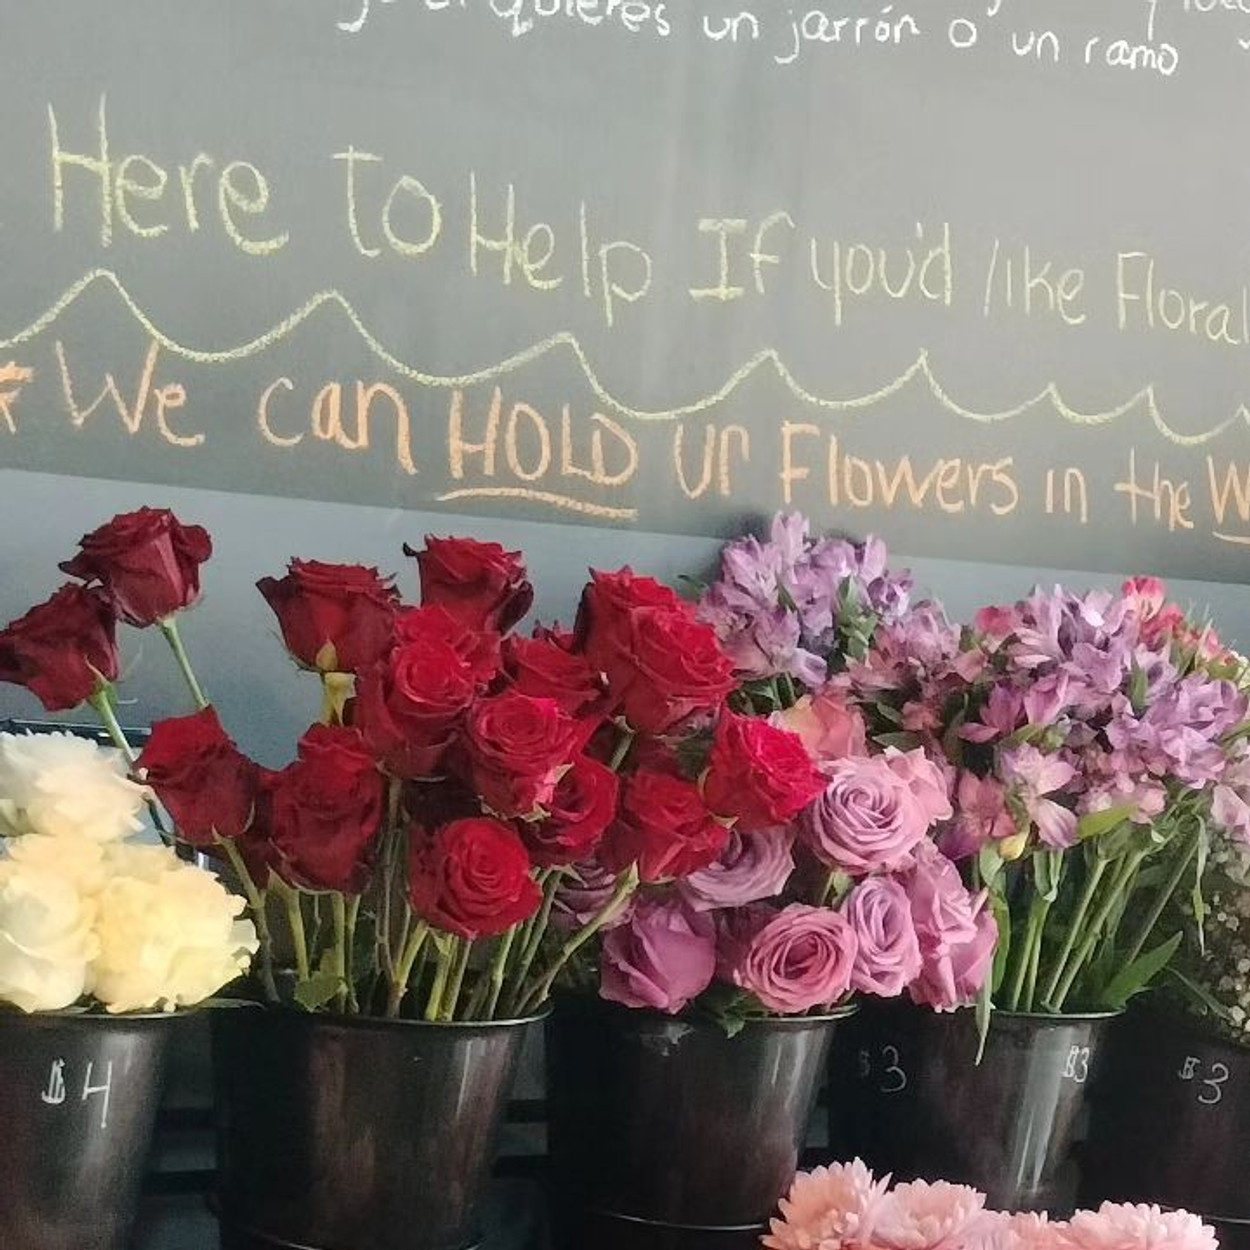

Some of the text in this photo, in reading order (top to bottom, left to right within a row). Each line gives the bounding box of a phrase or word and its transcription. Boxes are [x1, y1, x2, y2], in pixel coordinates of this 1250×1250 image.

[703, 12, 759, 41] un
[949, 18, 977, 48] o
[1012, 31, 1059, 62] un
[1085, 37, 1178, 75] ramo
[47, 94, 289, 256] Here
[470, 171, 652, 327] Help
[690, 210, 795, 301] If
[984, 239, 1086, 325] like
[1117, 250, 1250, 345] Floral
[56, 339, 206, 446] We
[258, 376, 419, 475] can
[449, 386, 639, 486] HOLD
[780, 419, 1019, 516] Flowers
[1045, 468, 1088, 523] in
[1114, 446, 1194, 532] the
